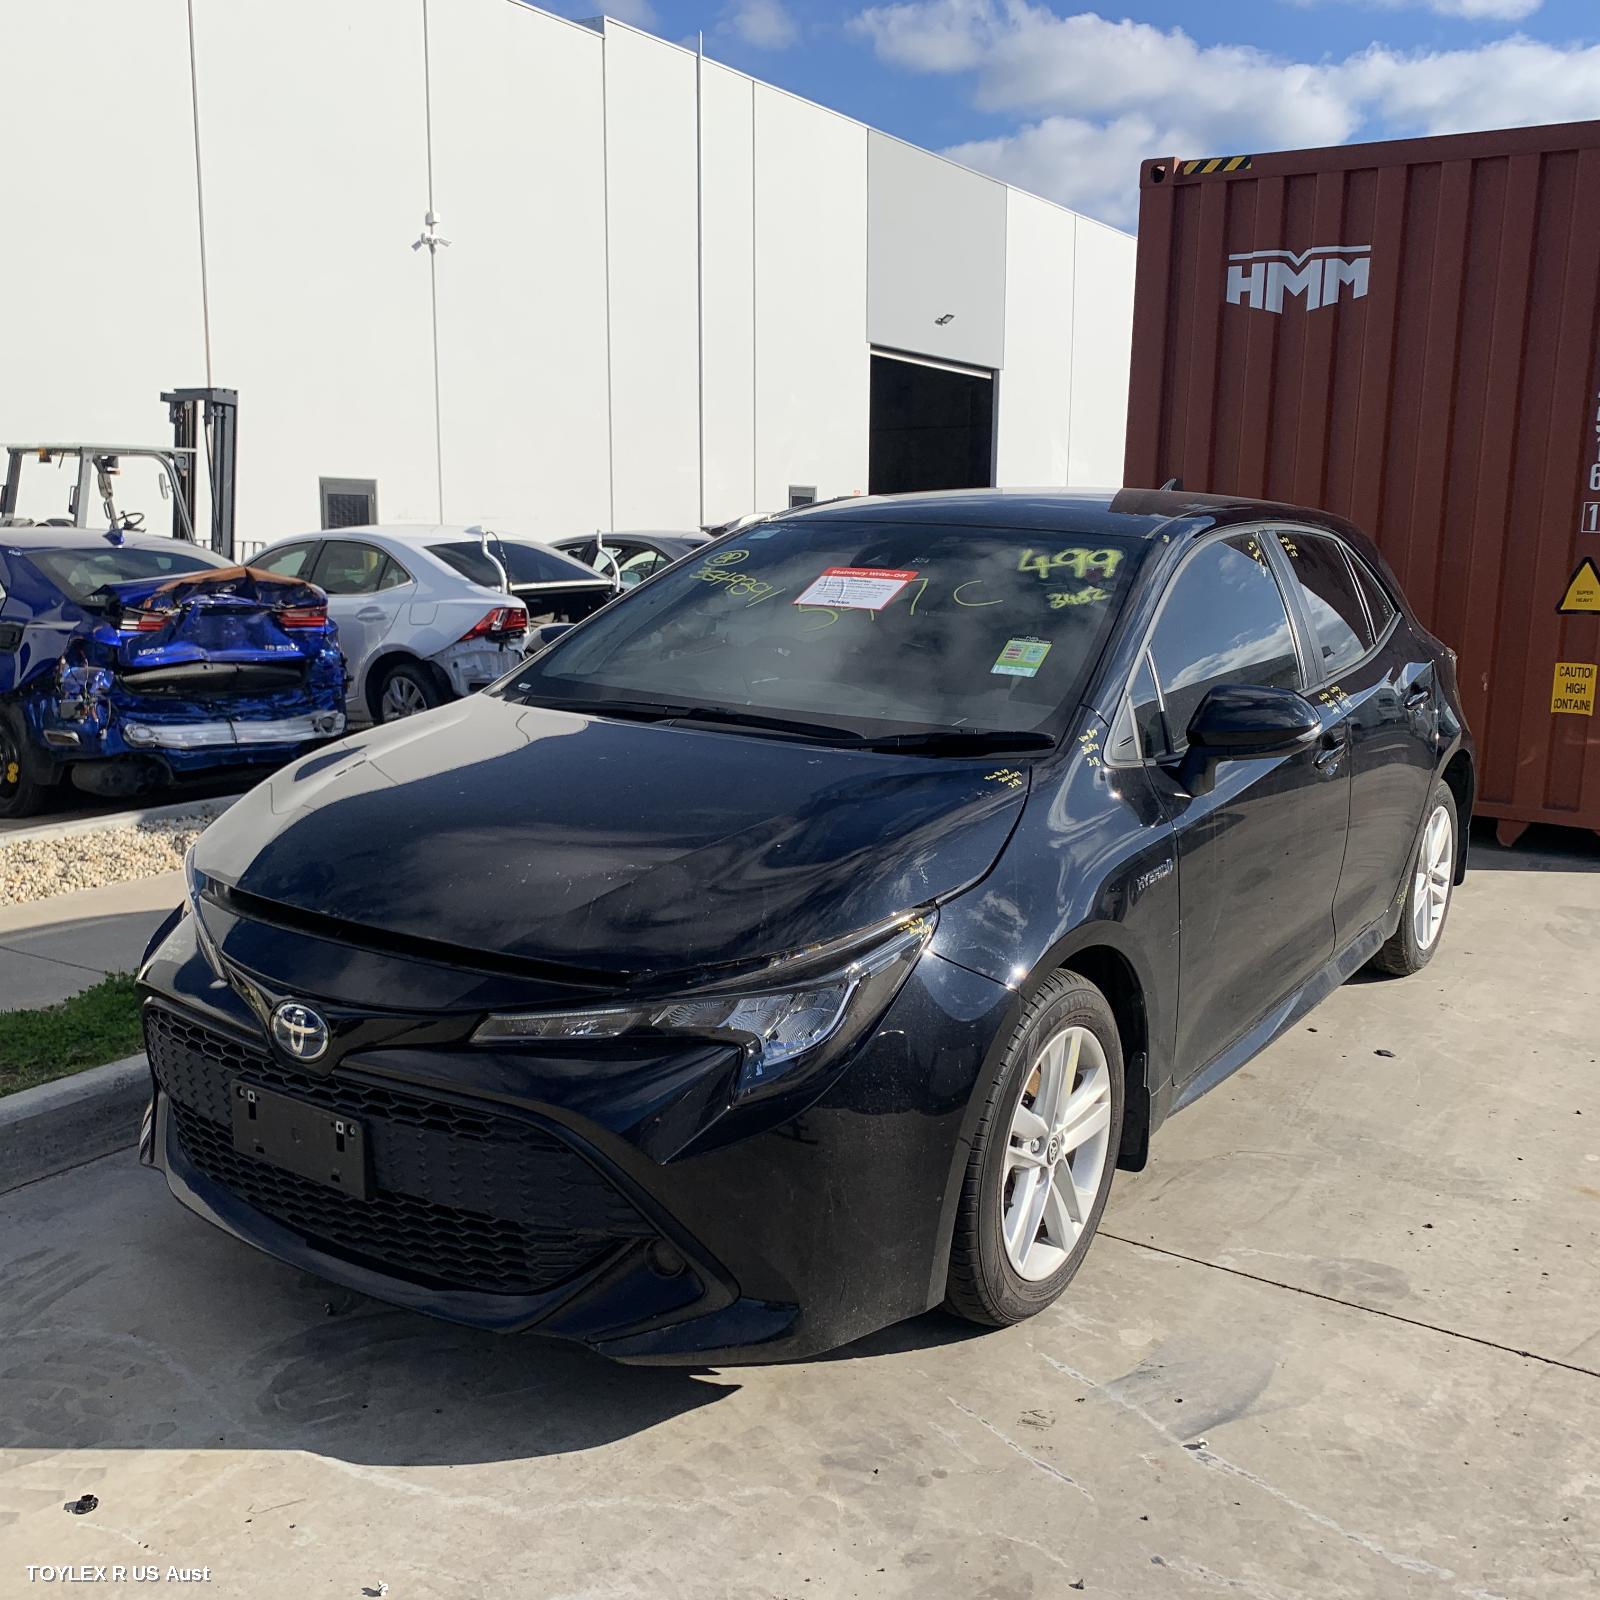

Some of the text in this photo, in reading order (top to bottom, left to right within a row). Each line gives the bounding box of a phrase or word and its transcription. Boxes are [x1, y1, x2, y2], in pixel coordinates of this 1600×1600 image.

[1227, 257, 1371, 314] HMM
[1018, 548, 1124, 578] 499
[1559, 666, 1593, 678] CAUTIO
[1565, 683, 1587, 694] HIGH
